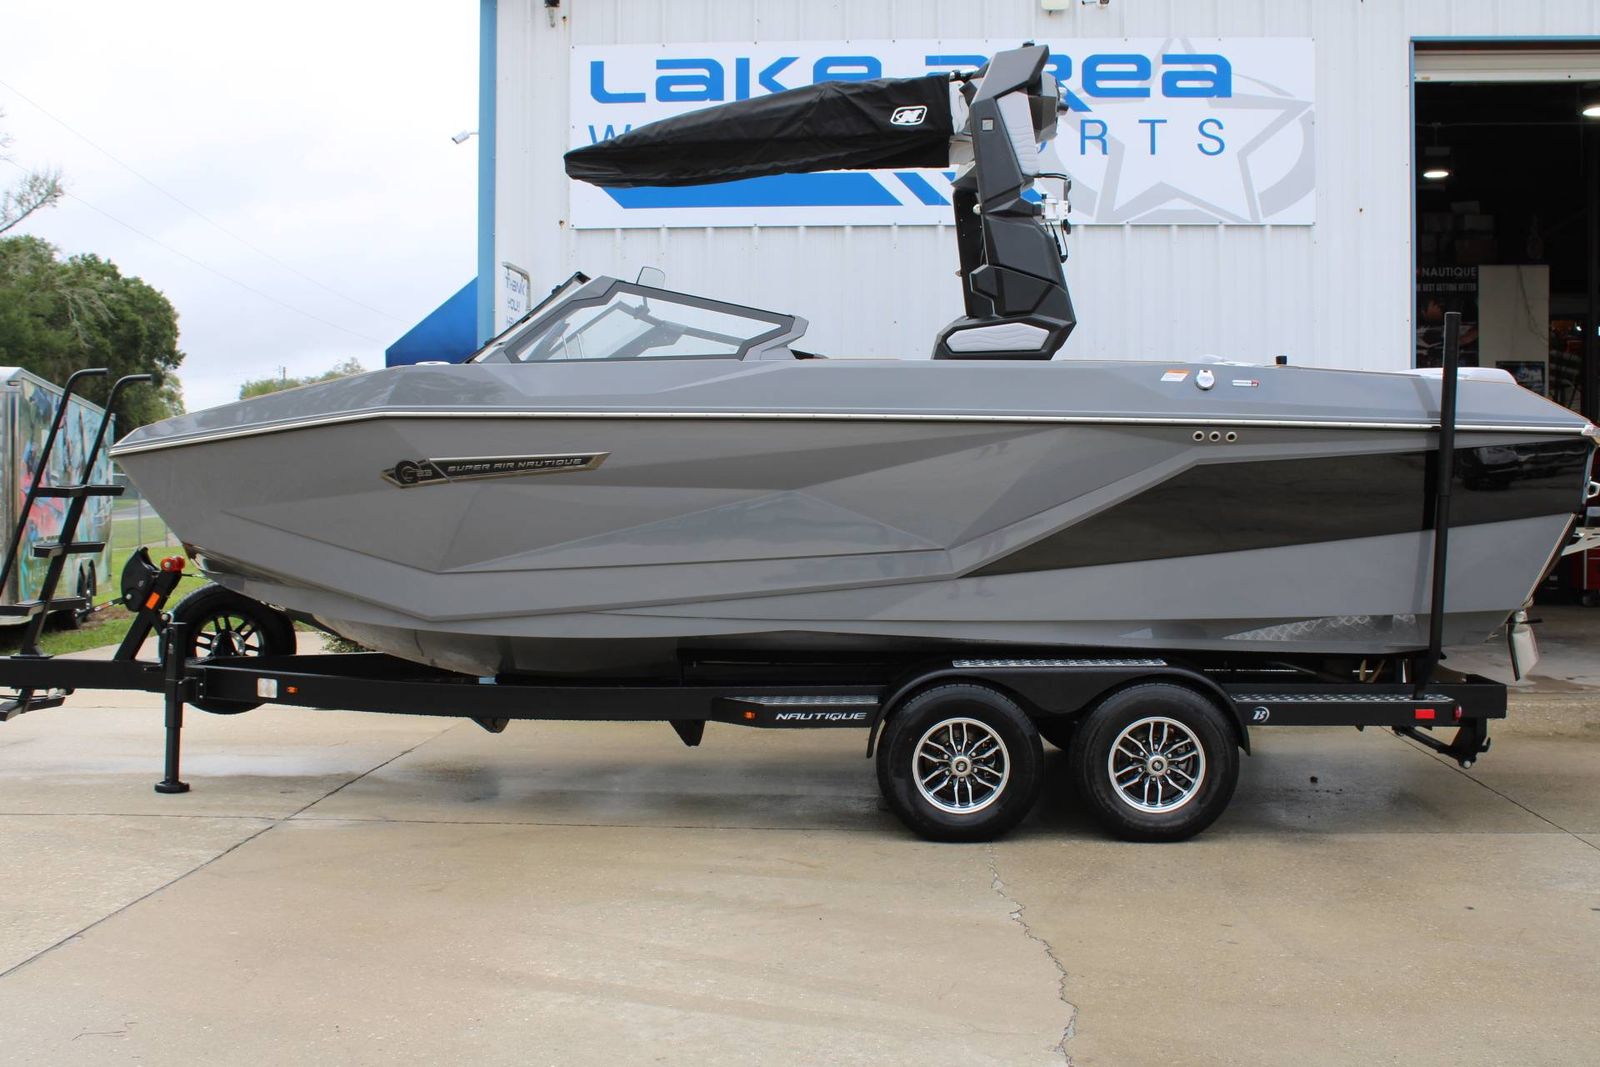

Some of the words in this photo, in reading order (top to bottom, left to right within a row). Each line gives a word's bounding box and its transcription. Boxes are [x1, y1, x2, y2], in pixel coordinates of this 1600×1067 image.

[1422, 266, 1476, 277] NAUTIQUE
[447, 462, 490, 473] SUPER
[493, 461, 514, 470] AIR
[518, 458, 583, 469] NAUTIQUE
[775, 712, 867, 721] NAUTIQUE
